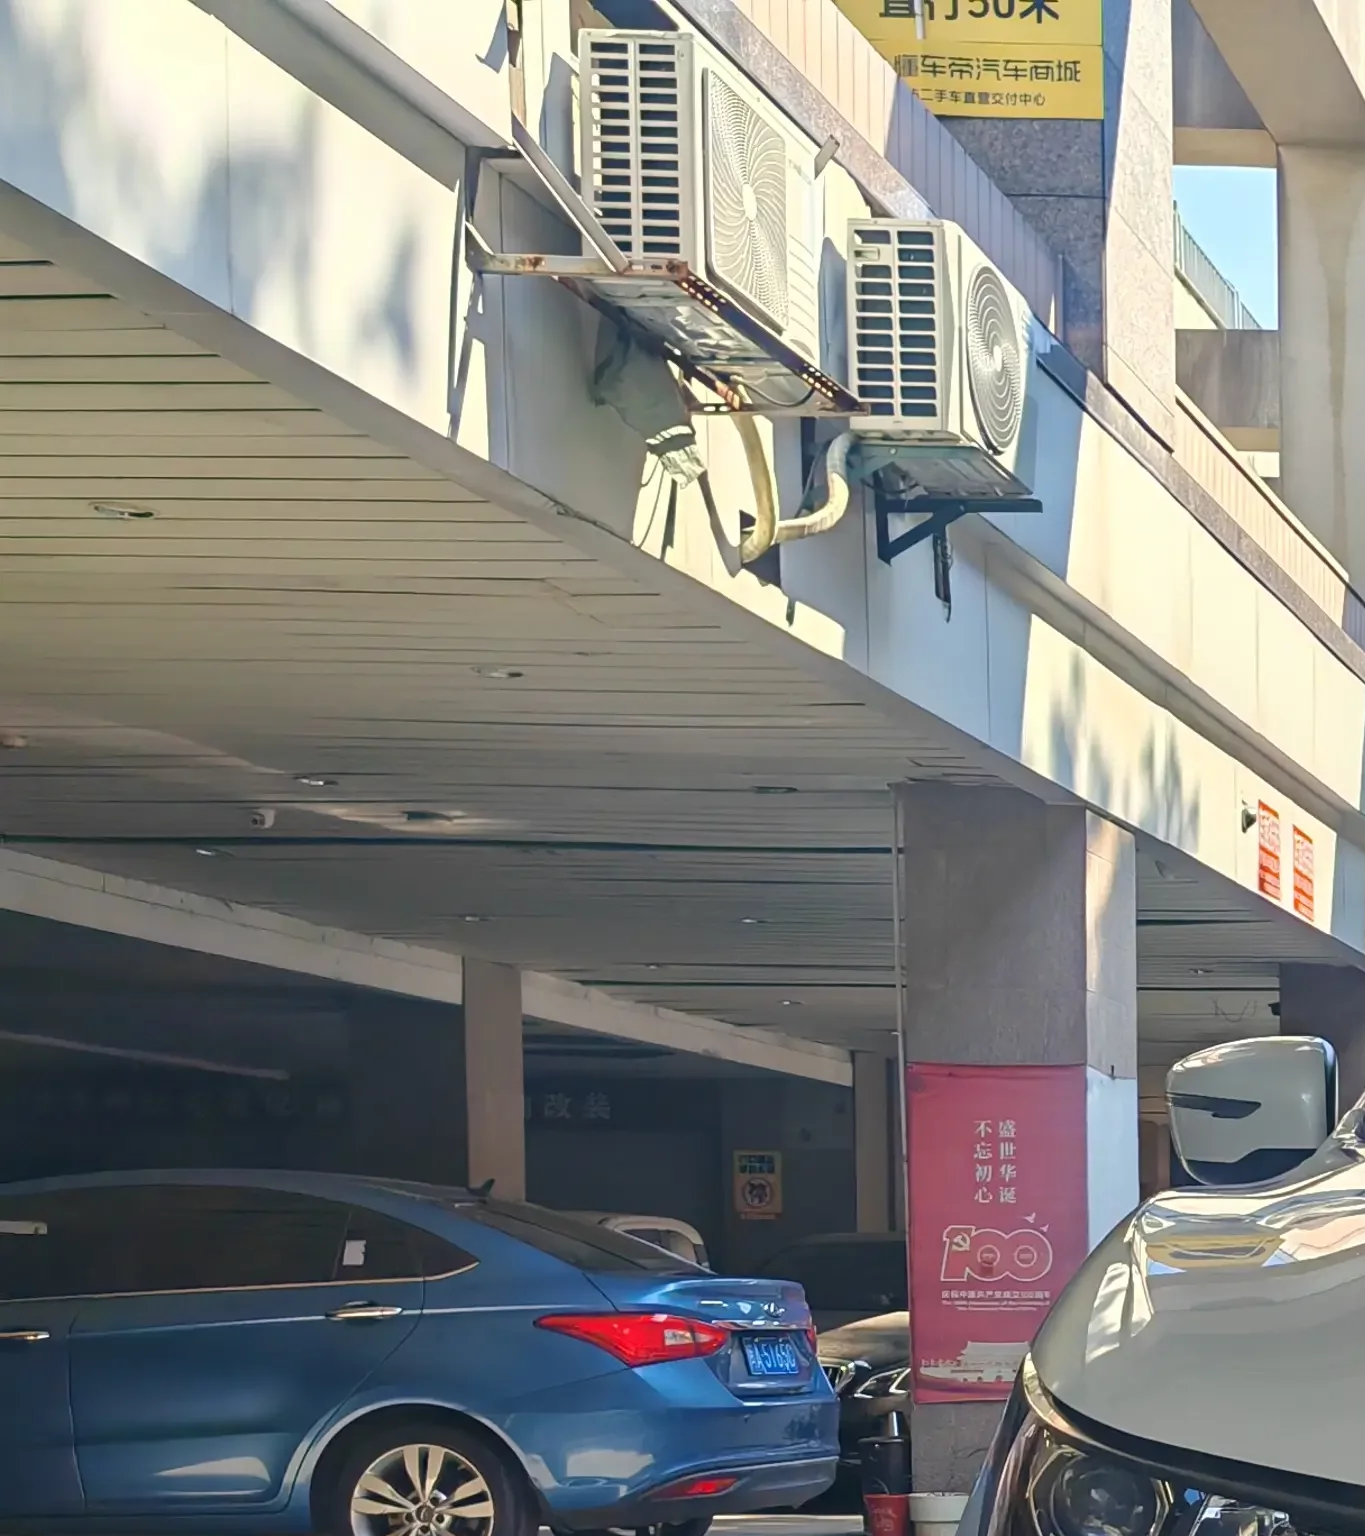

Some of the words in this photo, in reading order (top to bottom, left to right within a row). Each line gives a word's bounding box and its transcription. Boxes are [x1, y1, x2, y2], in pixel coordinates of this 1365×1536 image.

[894, 54, 1081, 83] 懂车帝汽车商城
[524, 1092, 611, 1119] 改装
[974, 1119, 993, 1204] 不忘初心
[999, 1119, 1017, 1204] 盛世华诞
